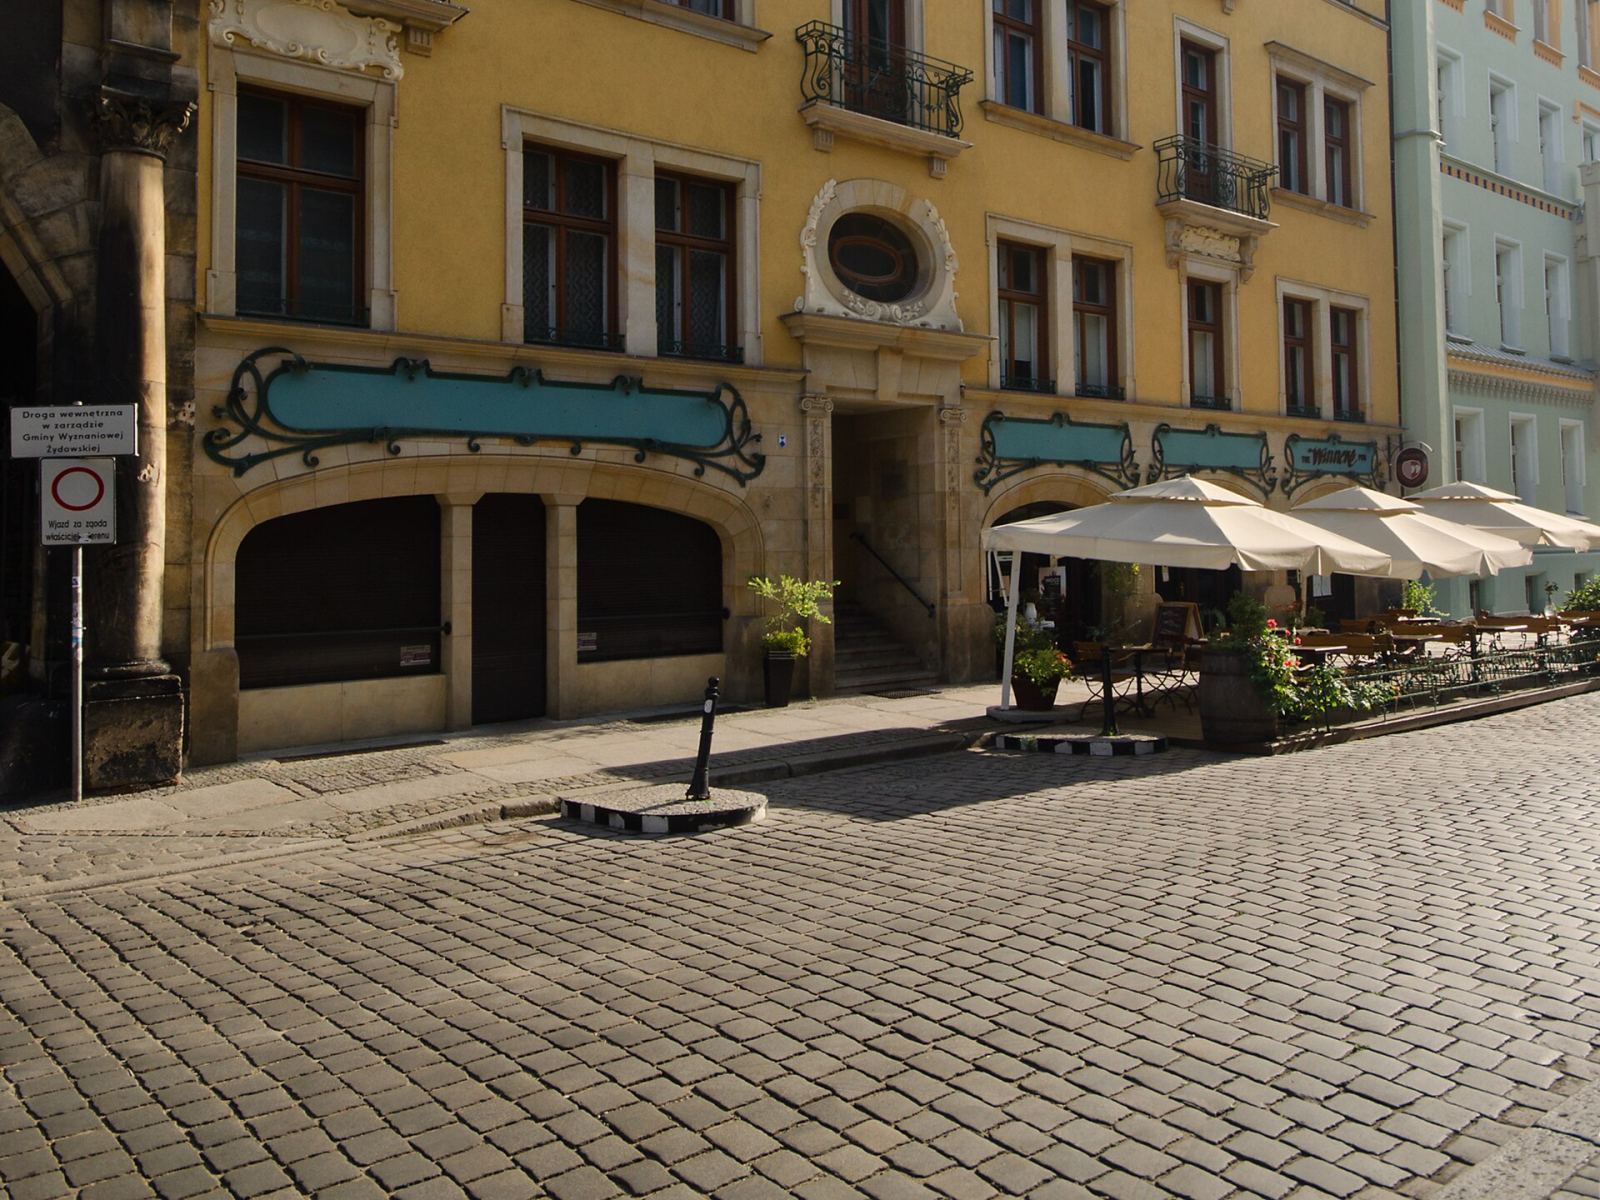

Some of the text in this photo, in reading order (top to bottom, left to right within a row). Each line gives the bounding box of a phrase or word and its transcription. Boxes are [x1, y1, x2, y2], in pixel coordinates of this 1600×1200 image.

[22, 411, 55, 420] Droga
[54, 421, 104, 430] zarządzie
[22, 431, 124, 442] Gminy Wyznaniowej
[48, 520, 70, 529] Wjazd
